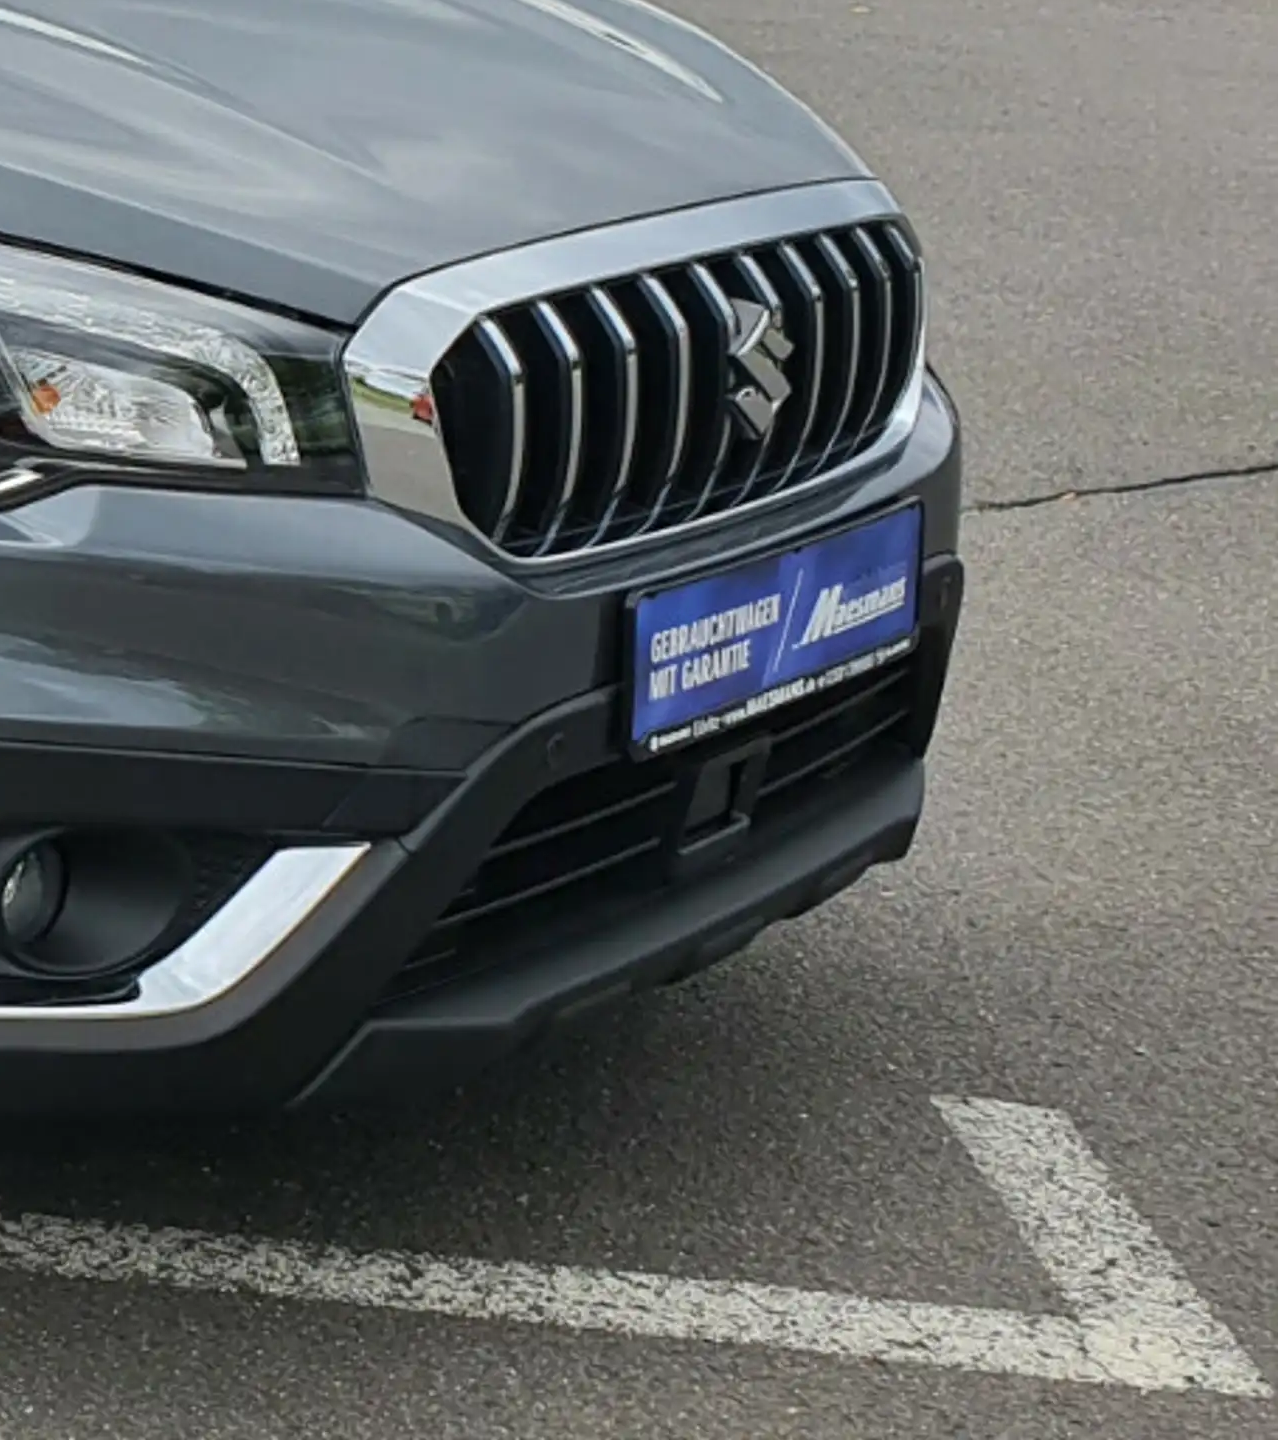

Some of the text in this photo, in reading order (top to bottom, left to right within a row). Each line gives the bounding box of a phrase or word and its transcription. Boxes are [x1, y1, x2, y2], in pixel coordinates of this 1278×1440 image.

[650, 593, 781, 664] GEBRAUCHTWAGEN
[648, 638, 751, 701] MIT GARANTIE
